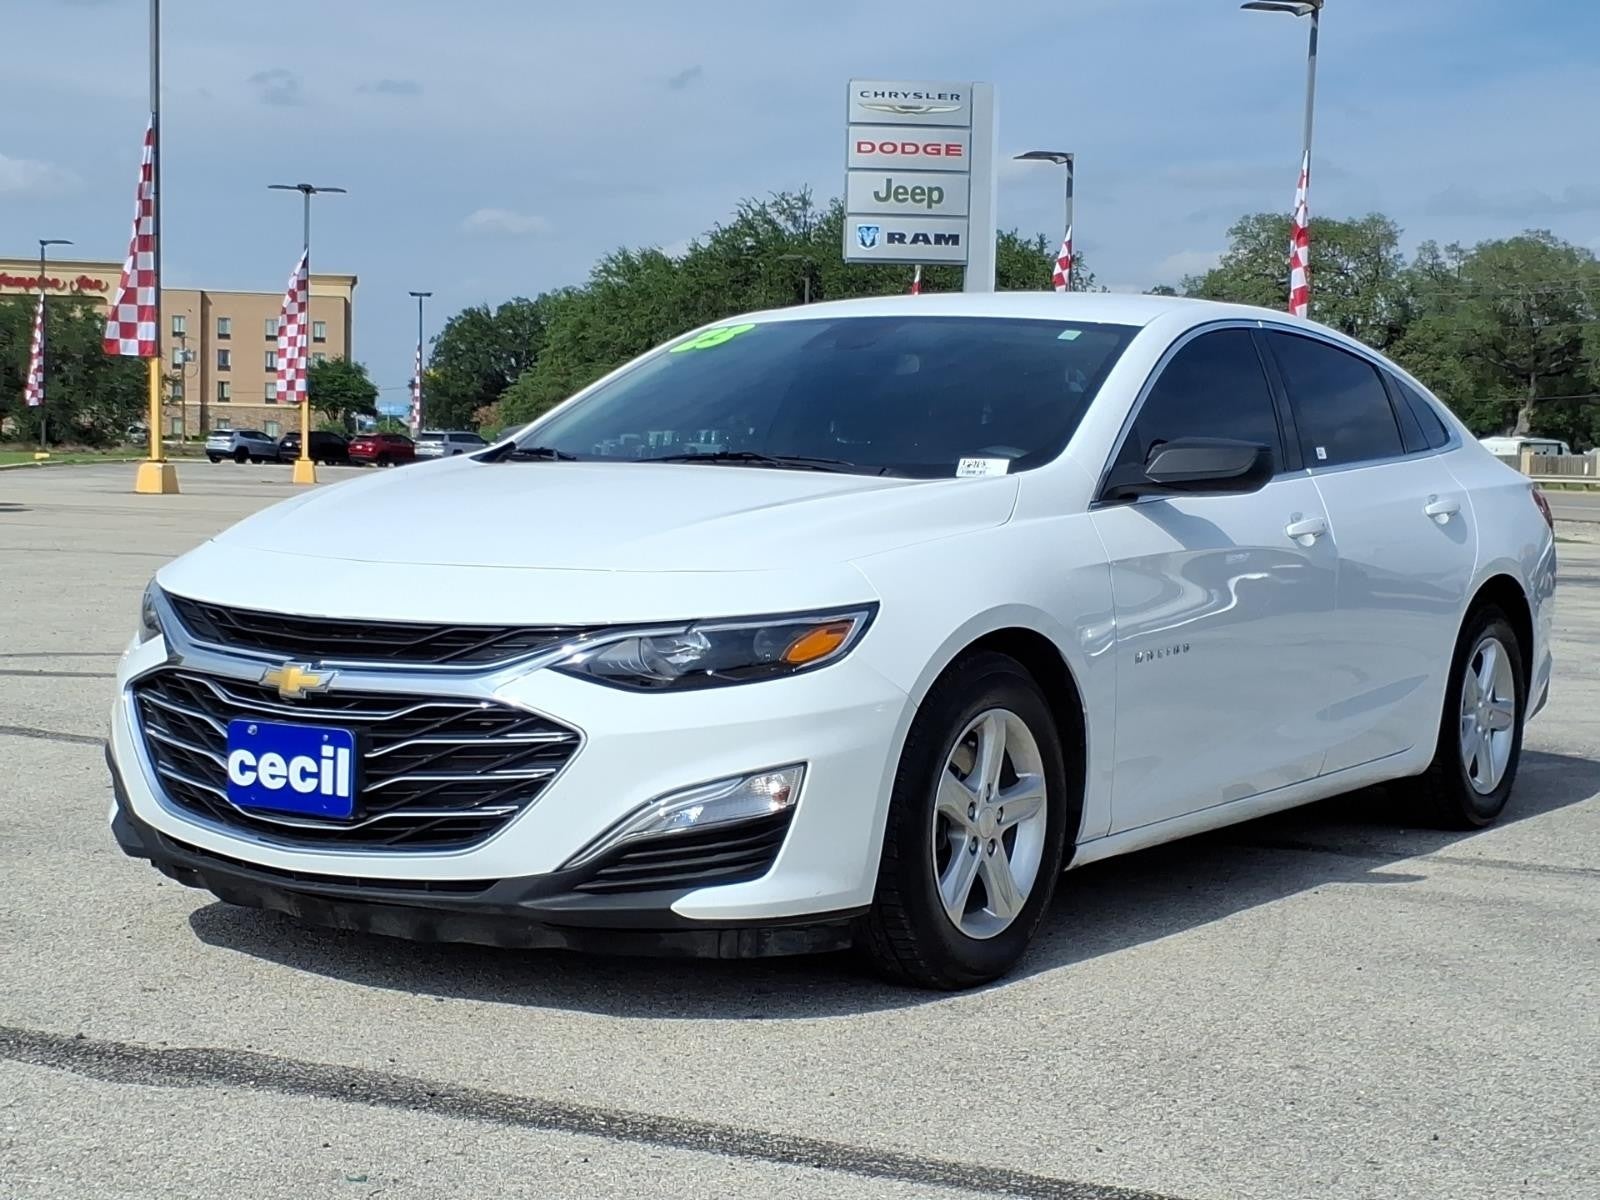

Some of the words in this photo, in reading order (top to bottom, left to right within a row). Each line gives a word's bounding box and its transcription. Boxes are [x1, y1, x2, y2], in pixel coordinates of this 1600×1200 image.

[859, 90, 961, 101] CHRYSLER
[856, 141, 963, 157] DODGE
[873, 178, 945, 209] Jeep
[886, 231, 960, 246] RAM
[228, 744, 350, 798] cecil
